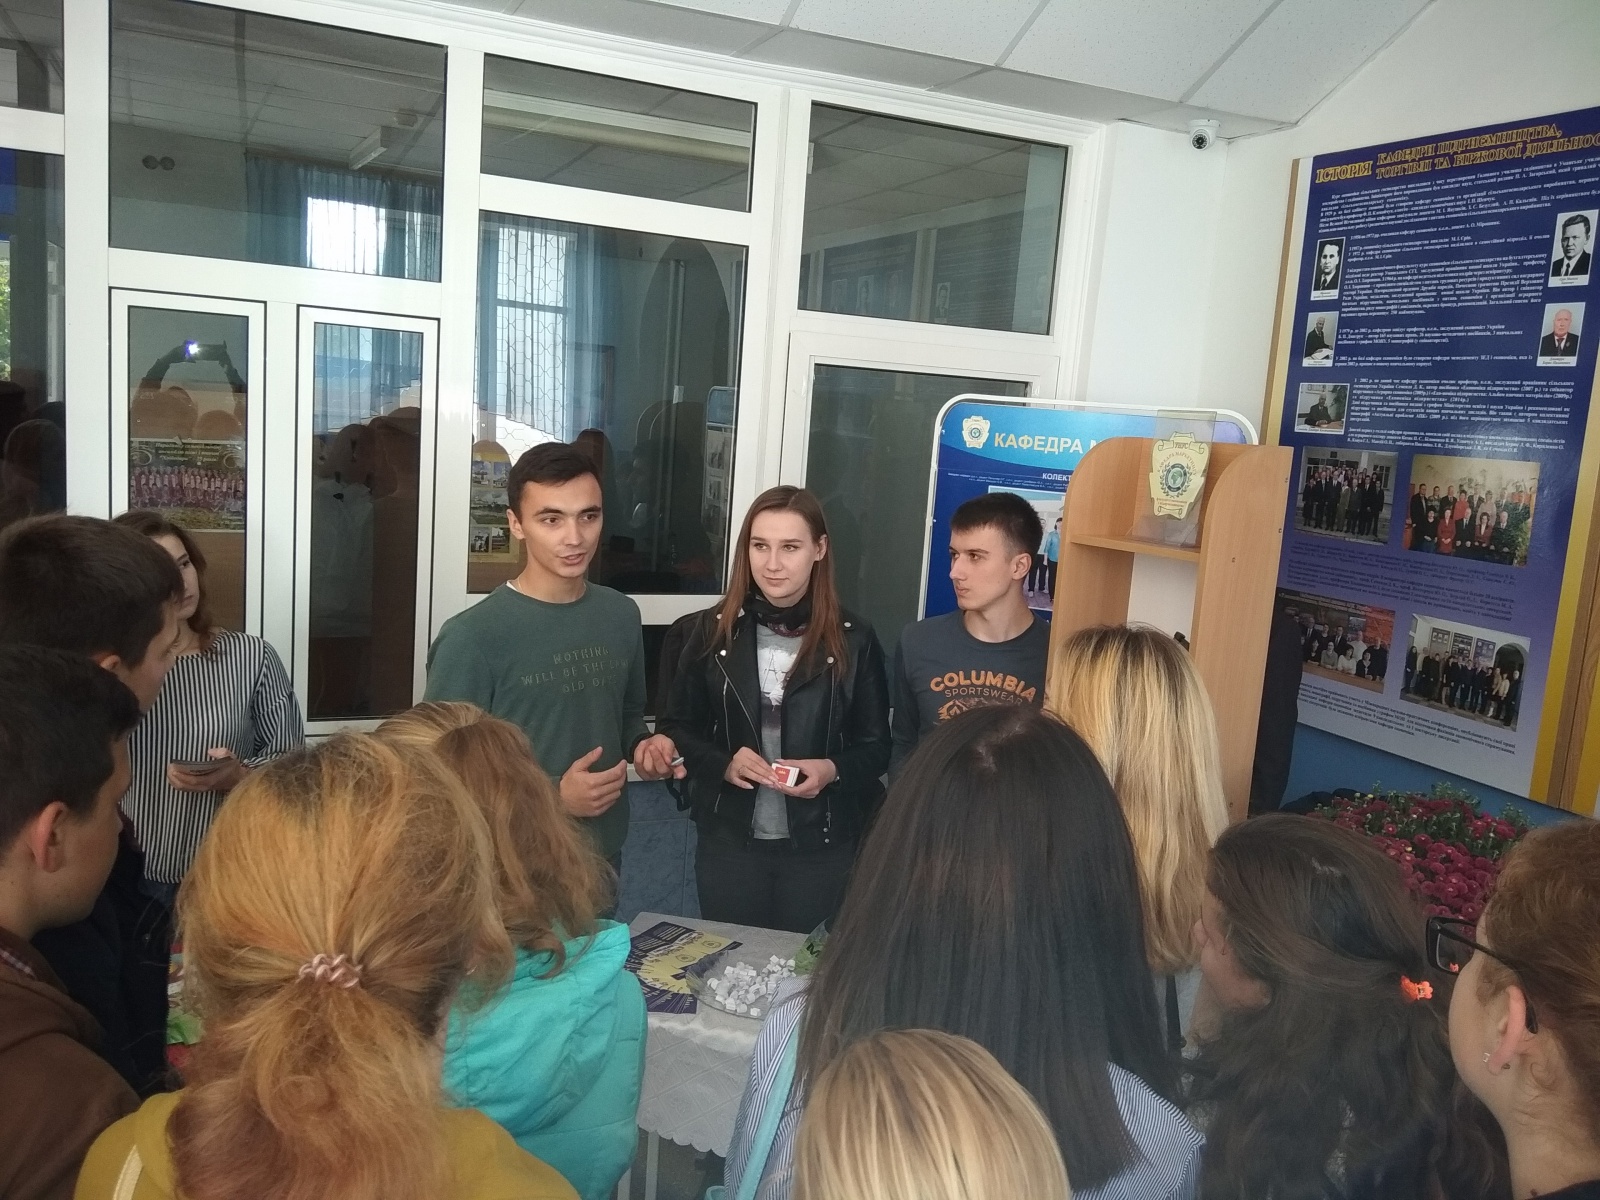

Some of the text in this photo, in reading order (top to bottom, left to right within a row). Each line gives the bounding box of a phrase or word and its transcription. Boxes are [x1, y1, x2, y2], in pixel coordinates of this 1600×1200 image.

[1376, 143, 1436, 165] КАФЕДРИ
[1434, 156, 1451, 170] ТА
[1453, 142, 1522, 167] БІРЖОВОЇ
[1523, 132, 1600, 159] ДІЯЛЬНОС
[1315, 160, 1373, 184] ІСТОРІЯ
[994, 432, 1084, 455] КАФЕДРА
[1042, 472, 1071, 482] КОЛЕКТ
[553, 646, 610, 665] NOTHING
[520, 670, 557, 687] WILL
[930, 670, 1037, 704] COLUMBIA
[944, 687, 1024, 707] SPORTSWEAR
